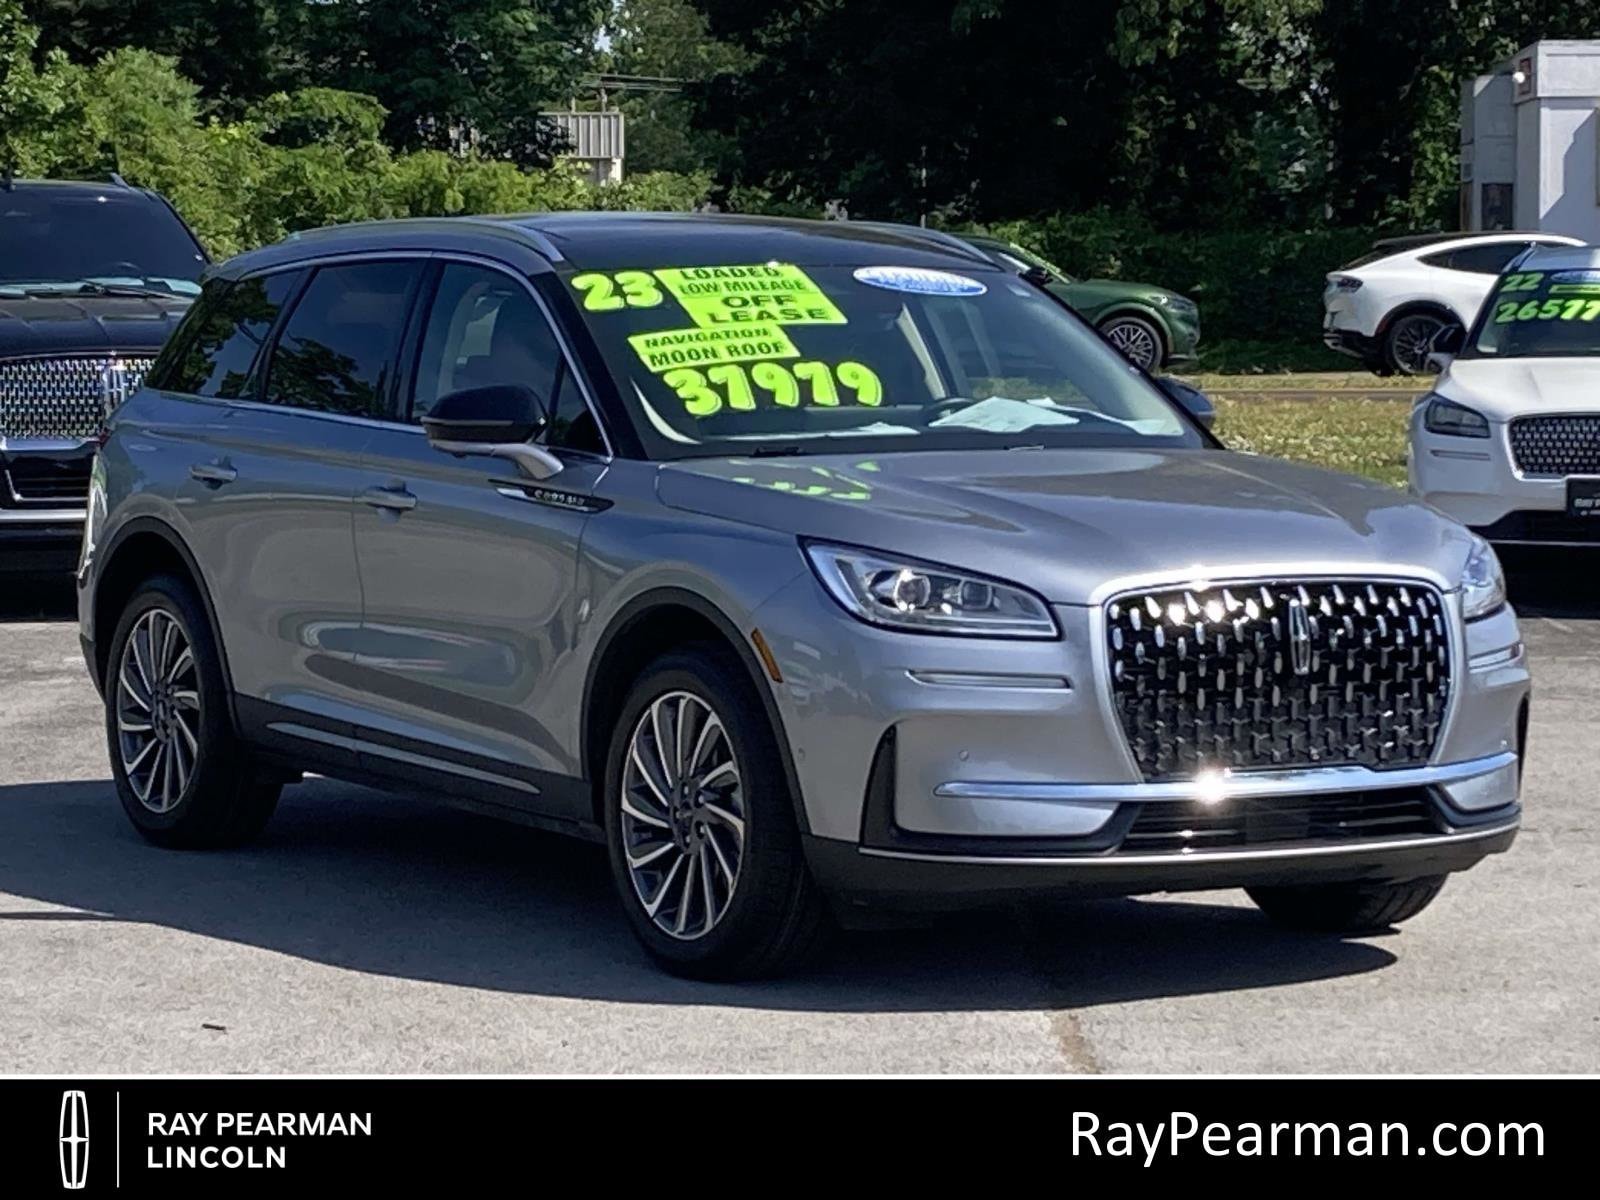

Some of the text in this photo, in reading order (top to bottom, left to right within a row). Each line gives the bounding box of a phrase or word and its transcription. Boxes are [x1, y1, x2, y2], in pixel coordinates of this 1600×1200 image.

[571, 270, 663, 311] 23
[678, 277, 807, 295] LOW MILEAGE
[1500, 272, 1545, 292] 22
[721, 294, 797, 308] OFF
[706, 308, 829, 324] LEASE
[644, 327, 773, 348] NAVIGATION
[650, 341, 787, 366] MOON ROOF
[663, 361, 883, 417] 37979
